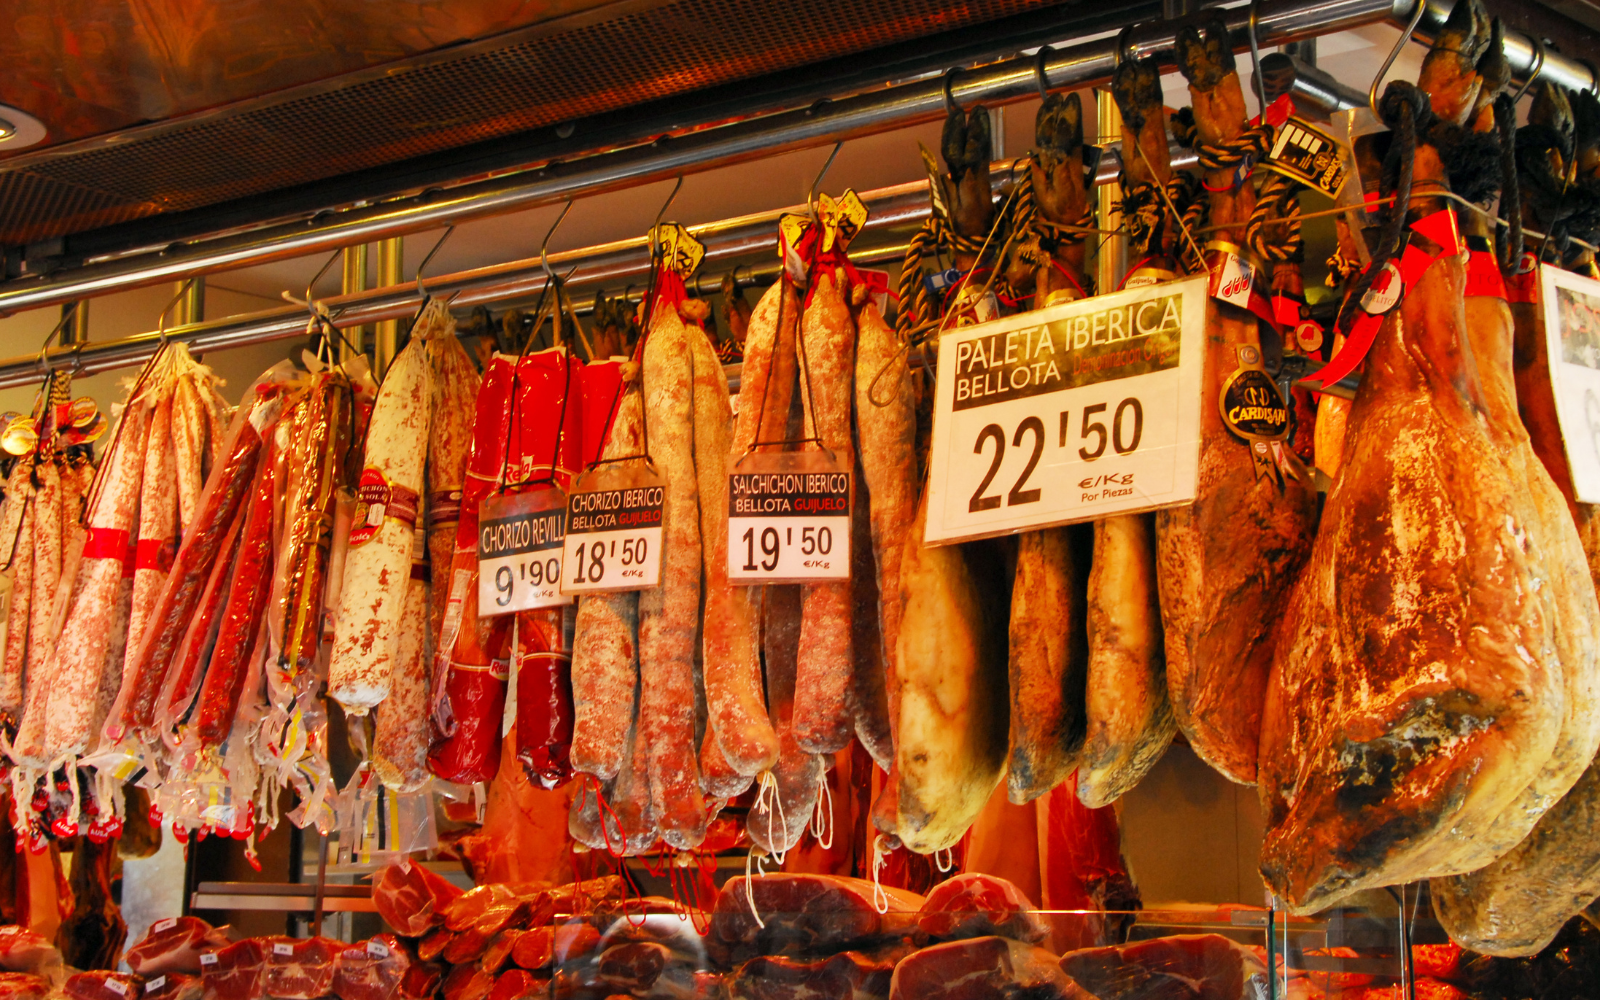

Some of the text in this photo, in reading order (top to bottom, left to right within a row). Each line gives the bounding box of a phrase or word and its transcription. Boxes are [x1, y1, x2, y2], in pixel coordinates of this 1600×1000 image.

[956, 297, 1181, 375] PALETA IBERICA
[957, 360, 1061, 401] BELLOTA
[1229, 405, 1286, 426] CARDISAN
[968, 397, 1144, 513] 22'50
[733, 474, 847, 494] SALCHICHON IBERICO
[1077, 473, 1134, 489] €/Kg
[1081, 486, 1133, 502] Por Piezas
[572, 487, 664, 513] CHORIZO IBERICO
[736, 497, 846, 514] BELLOTA GUIJUELO
[572, 510, 661, 529] BELLOTA GUIJUELO
[482, 515, 564, 554] CHORIZO REVILL
[573, 537, 647, 584] 18'50
[742, 526, 832, 571] 19'50
[803, 560, 830, 569] €/Kg
[495, 558, 560, 607] 9'90
